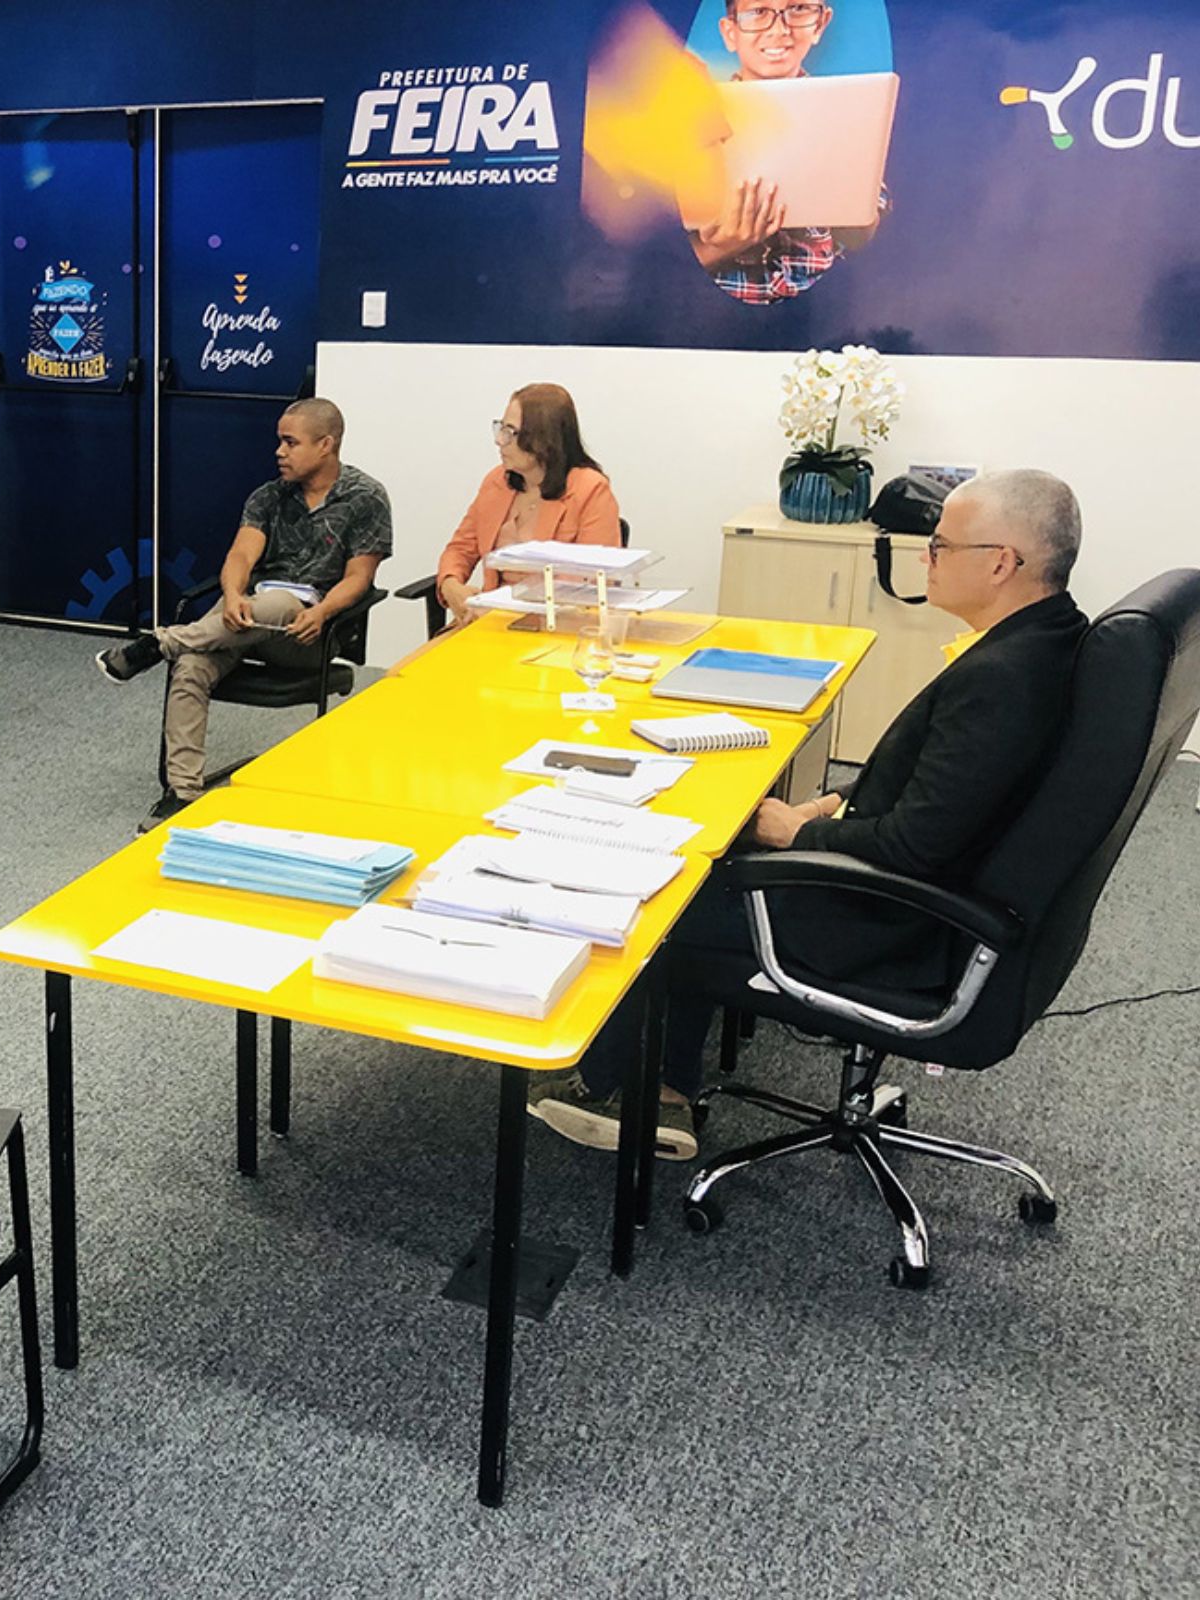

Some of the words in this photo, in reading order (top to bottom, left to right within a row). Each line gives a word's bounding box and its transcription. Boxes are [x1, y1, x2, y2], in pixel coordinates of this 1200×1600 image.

[379, 65, 495, 87] PREFEITURA
[501, 63, 529, 81] DE
[348, 81, 560, 156] FEIRA
[341, 173, 354, 189] A
[355, 172, 404, 188] GENTE
[405, 170, 435, 186] FAZ
[435, 169, 477, 185] MAIS
[478, 168, 511, 184] PRA
[512, 164, 559, 184] VOCÊ
[202, 303, 280, 339] Aprenda
[200, 339, 274, 372] fazendo
